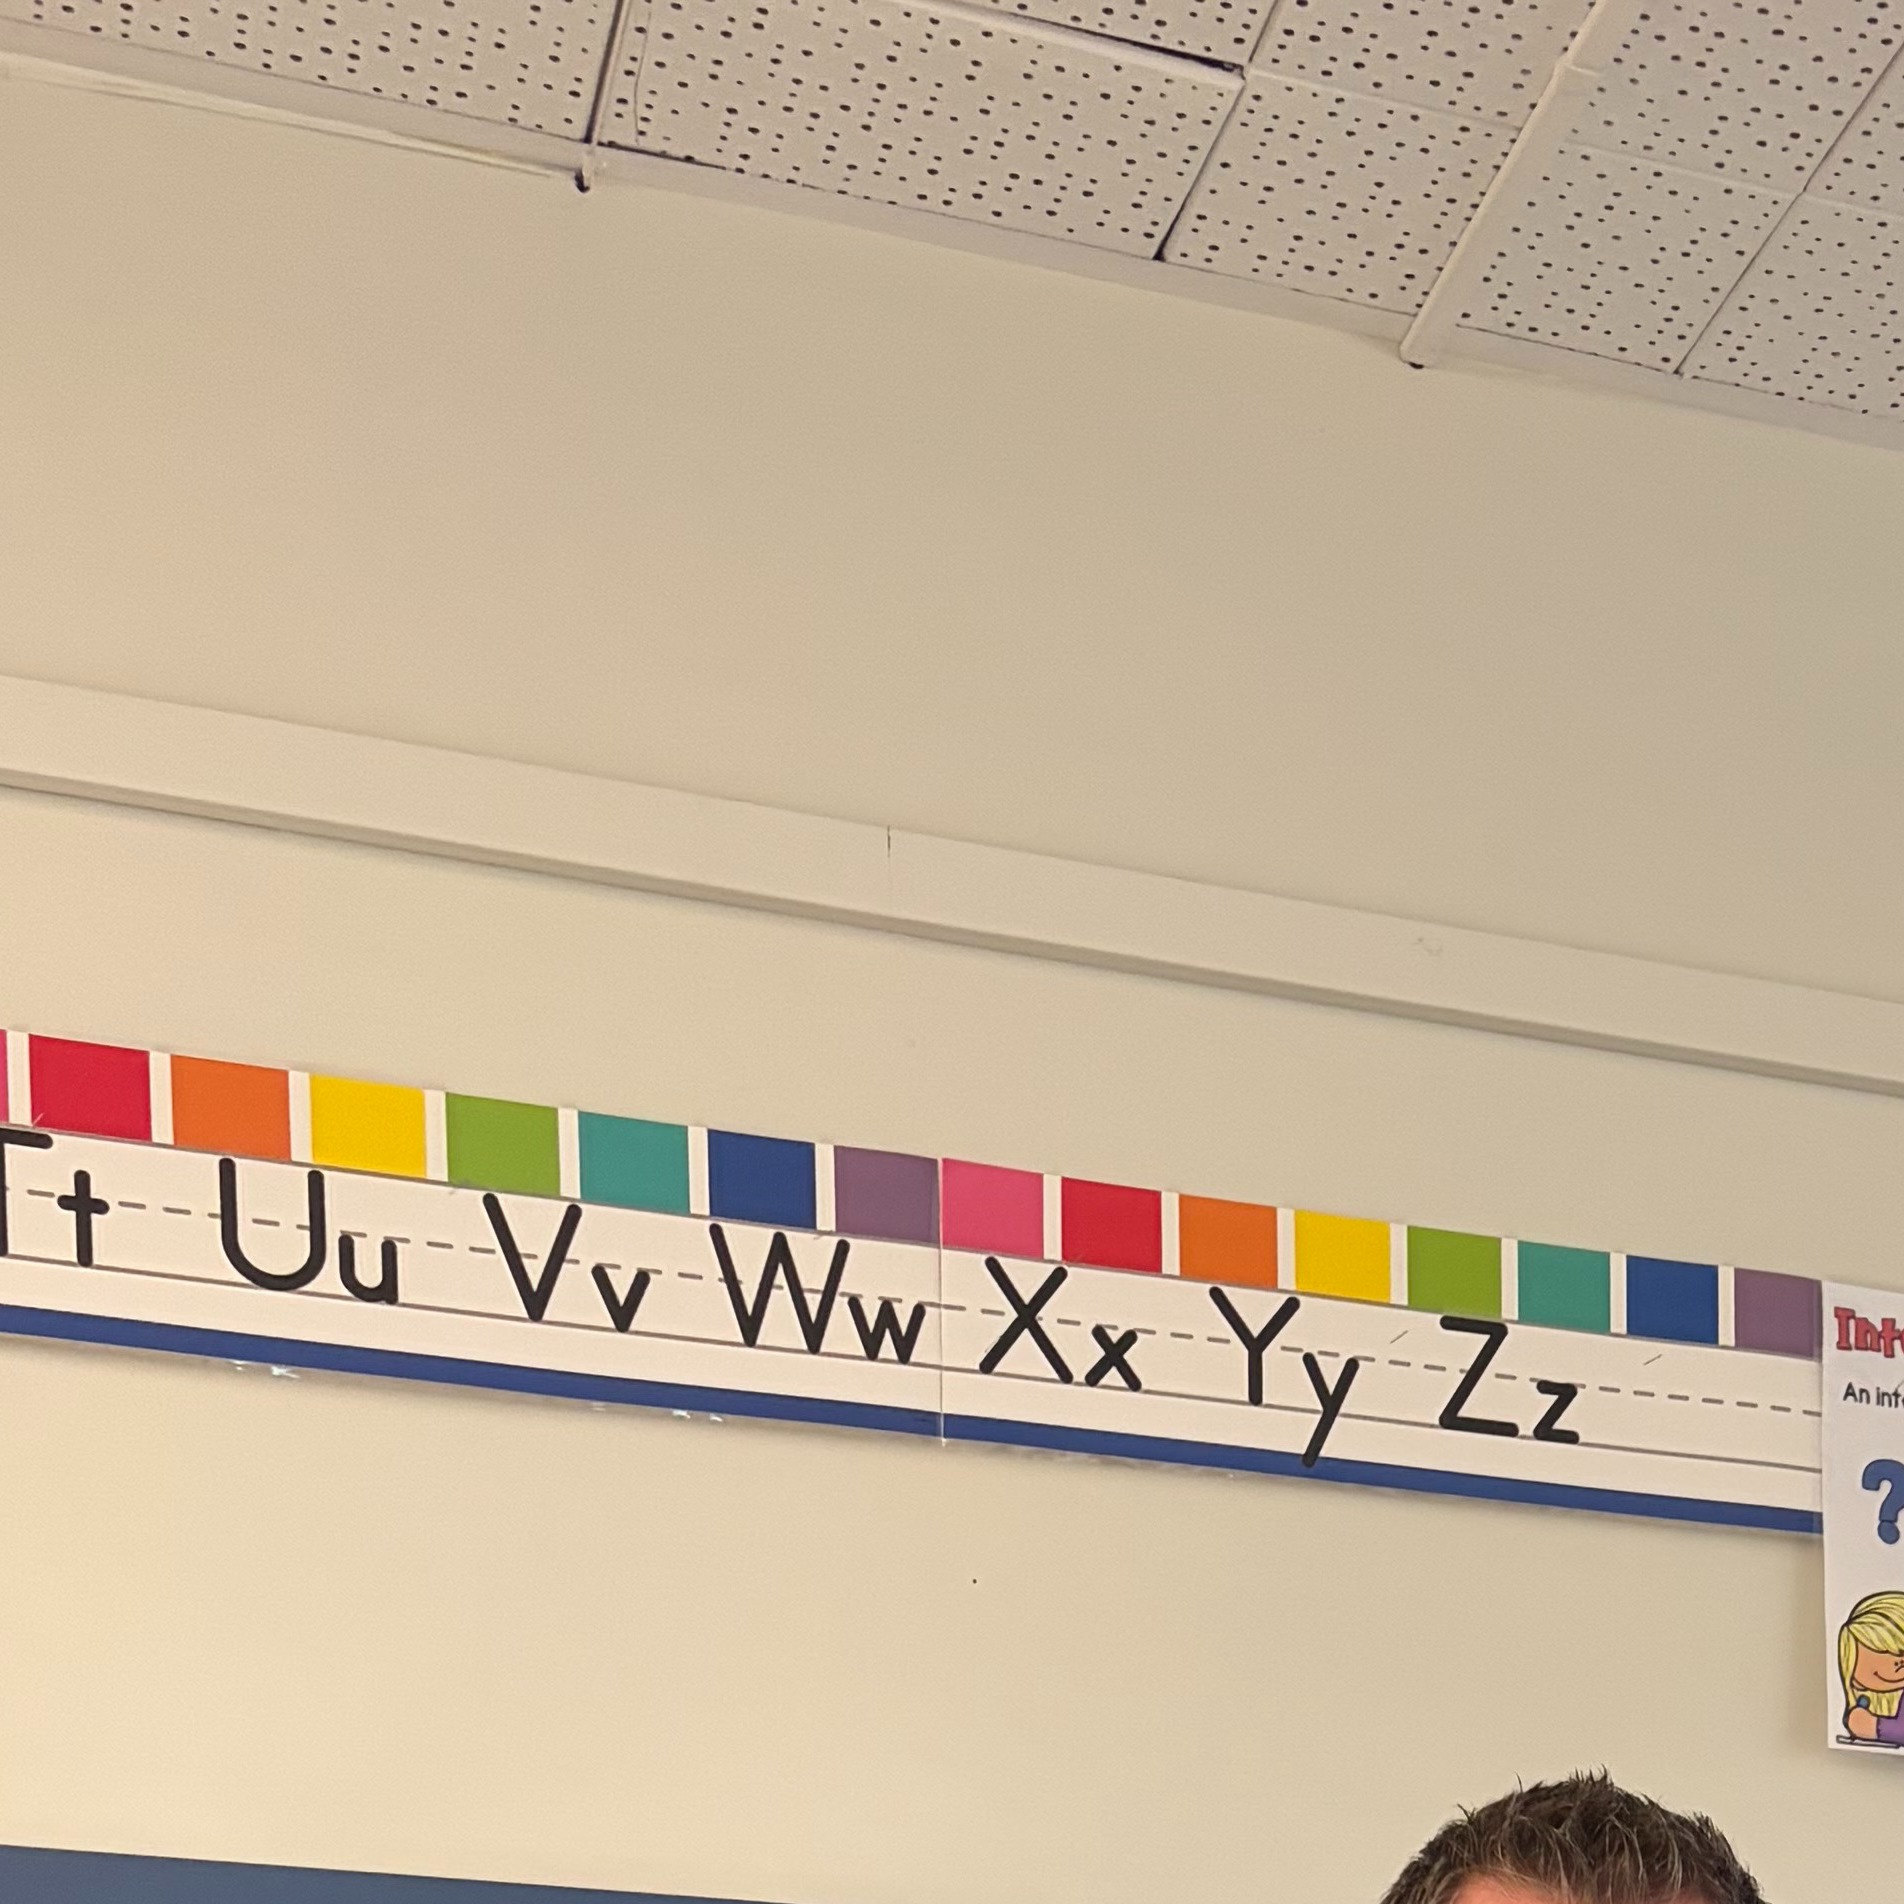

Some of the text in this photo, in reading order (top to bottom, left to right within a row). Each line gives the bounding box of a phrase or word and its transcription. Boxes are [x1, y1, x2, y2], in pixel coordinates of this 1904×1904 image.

[219, 1157, 401, 1306] Uu
[482, 1193, 652, 1333] Vv
[708, 1222, 927, 1364] Ww
[978, 1255, 1144, 1392] Xx
[1208, 1285, 1361, 1468] Yy
[1438, 1315, 1581, 1443] Zz
[1843, 1382, 1871, 1405] An
